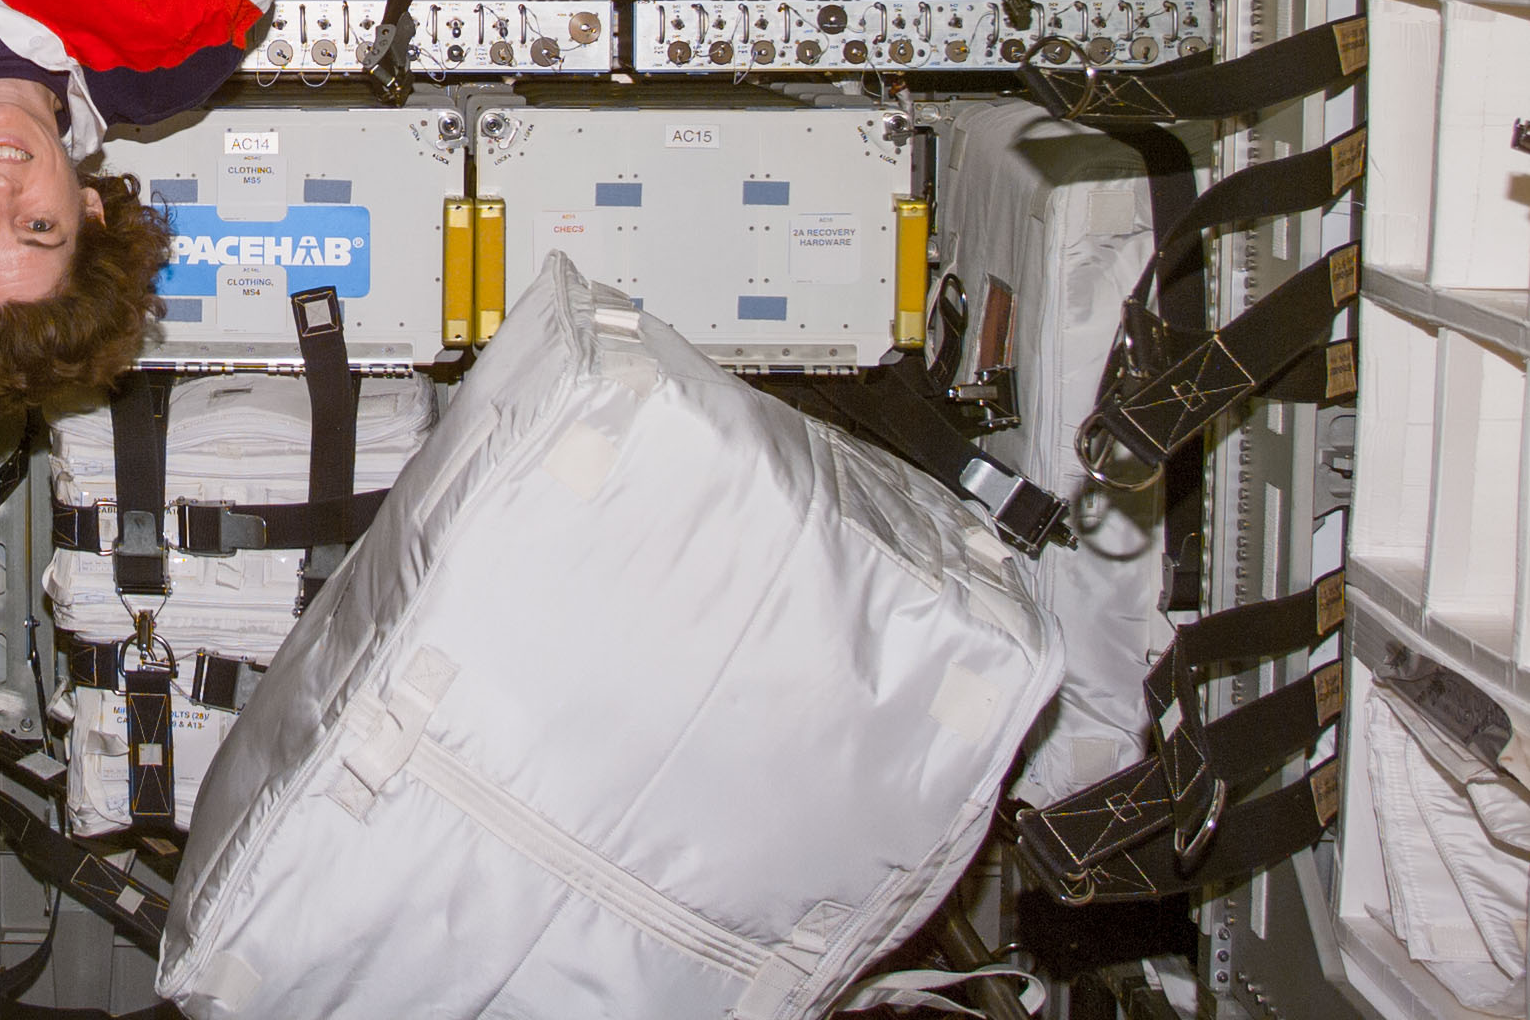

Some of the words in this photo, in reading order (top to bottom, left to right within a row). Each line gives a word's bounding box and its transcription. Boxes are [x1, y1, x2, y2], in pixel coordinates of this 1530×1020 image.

[672, 130, 712, 142] AC15
[231, 138, 270, 150] AC14
[553, 225, 584, 233] CHECS
[792, 229, 805, 237] 2A
[806, 228, 856, 237] RECOVERY
[799, 238, 851, 246] HARDWARE
[170, 235, 352, 266] PACEHAB
